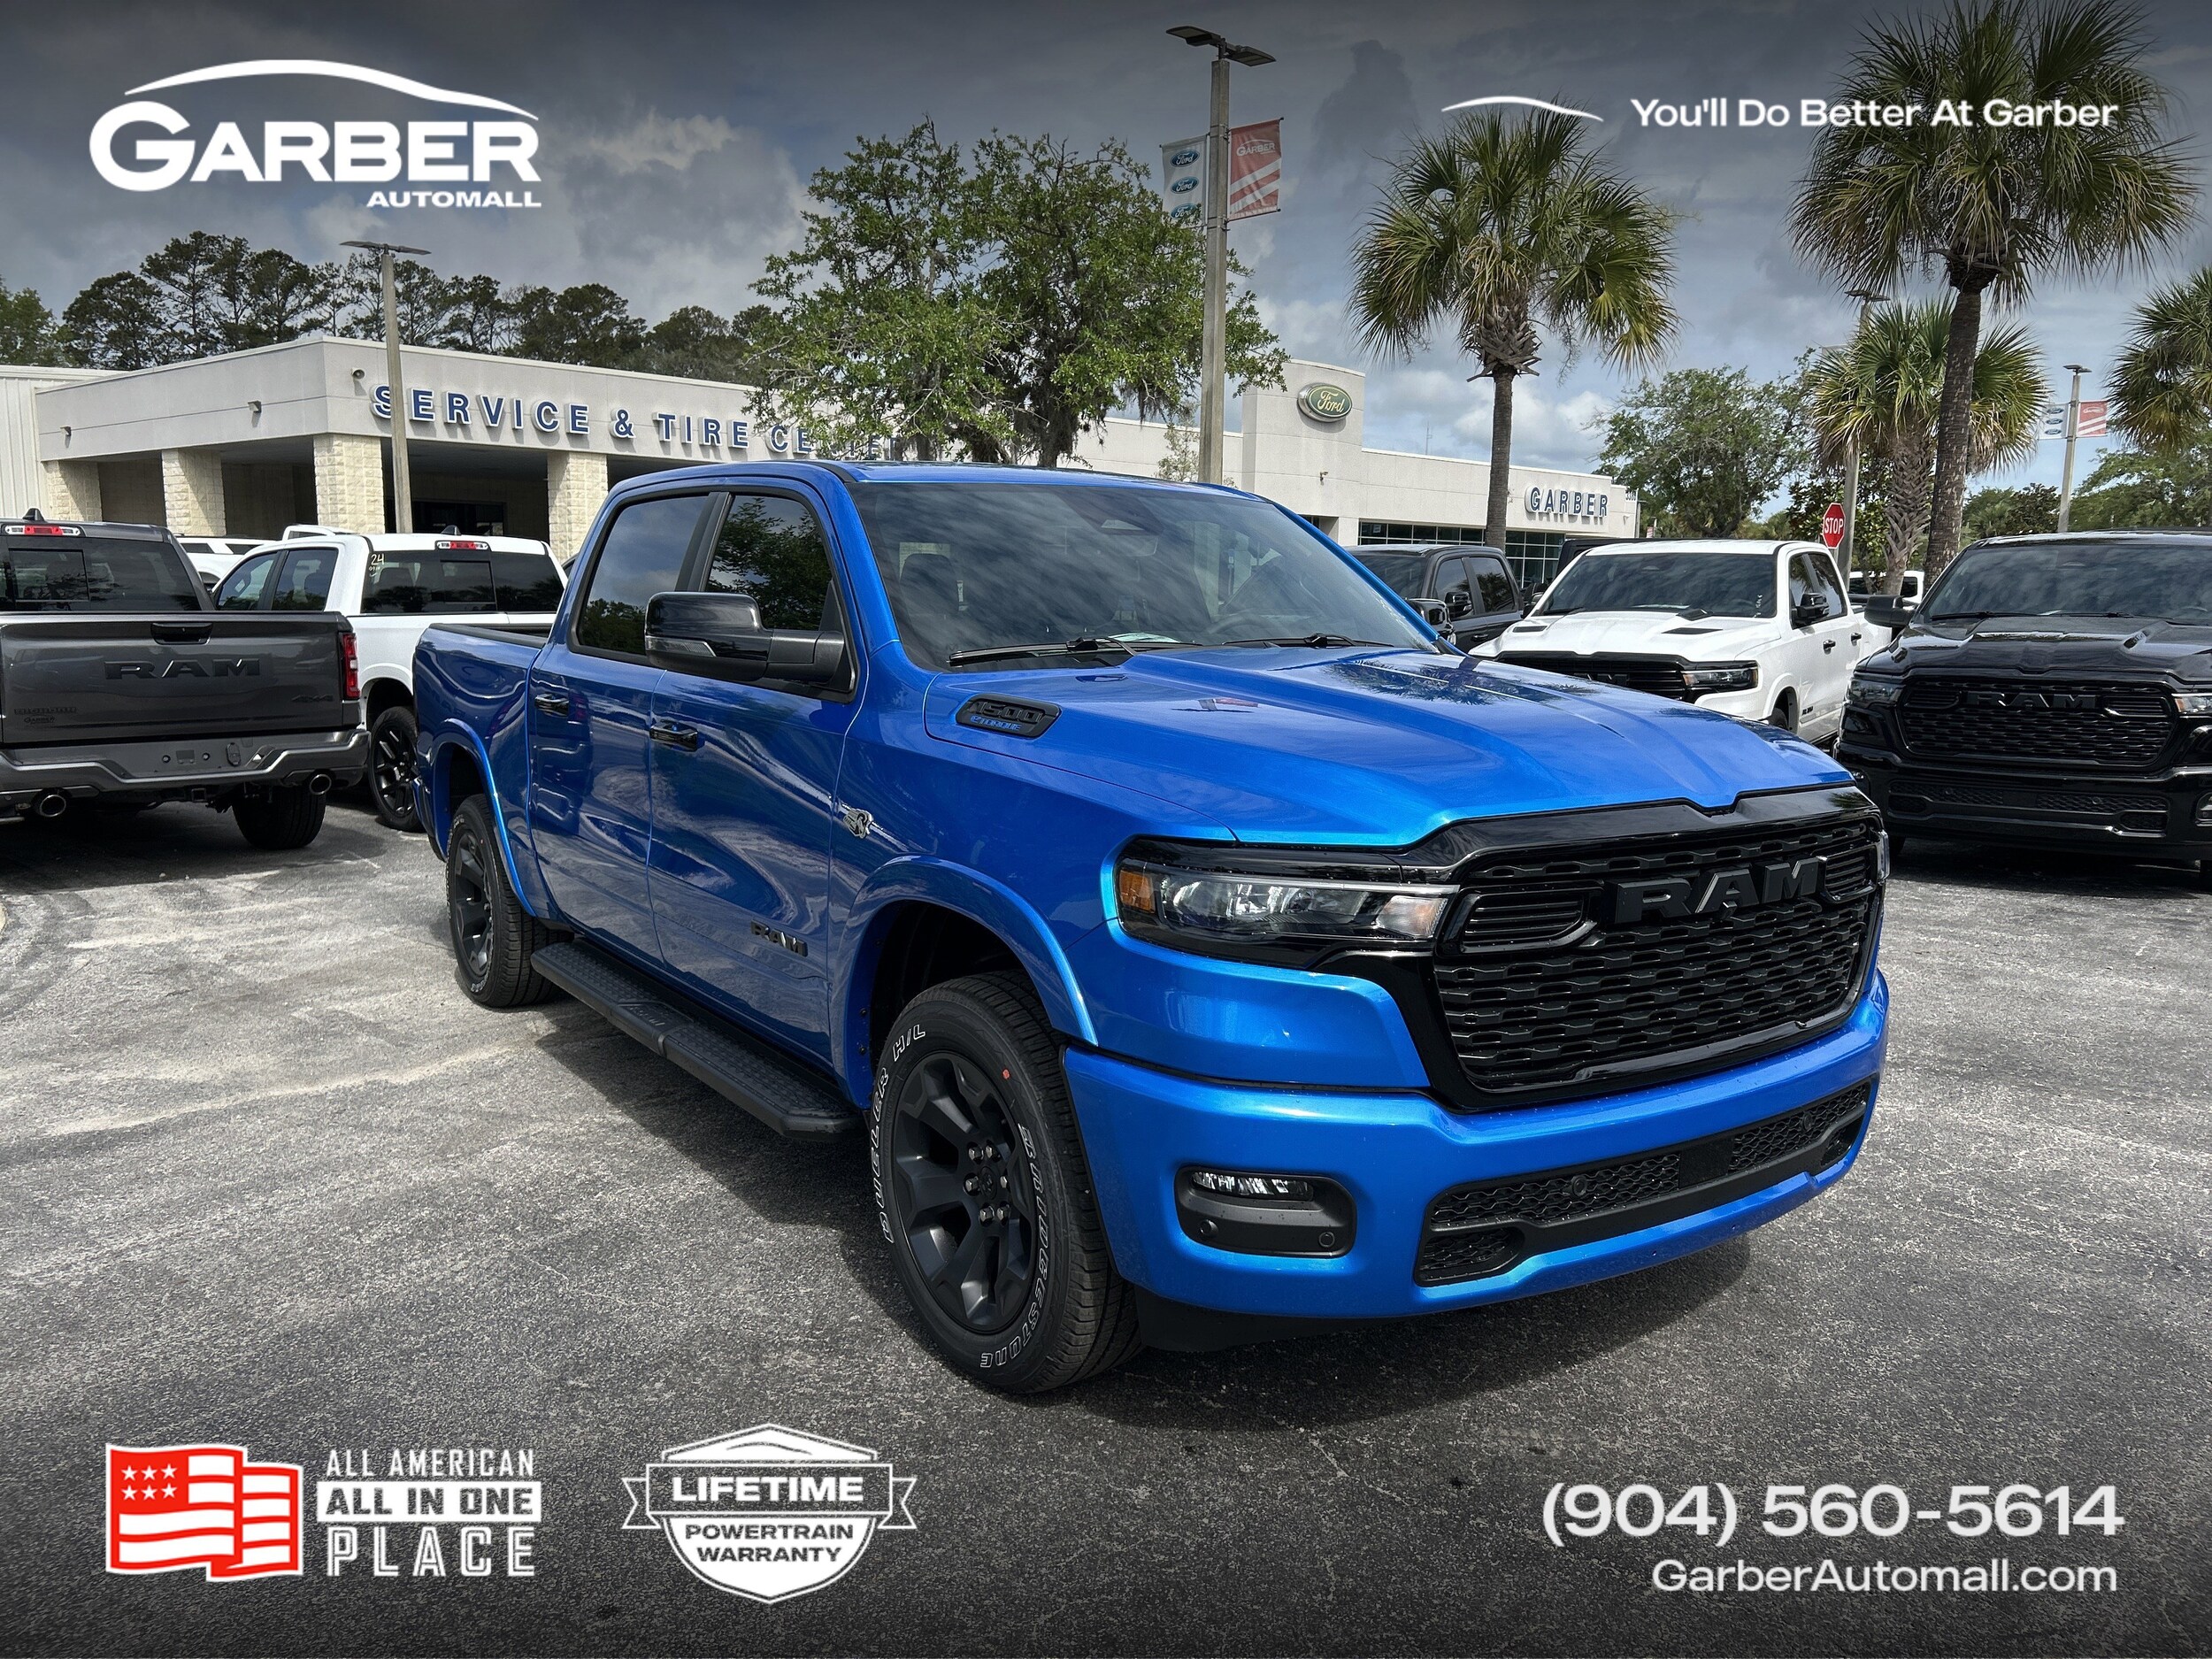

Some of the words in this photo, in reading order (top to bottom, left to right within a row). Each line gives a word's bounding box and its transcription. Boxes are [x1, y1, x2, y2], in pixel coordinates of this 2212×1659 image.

[1175, 152, 1194, 165] Ford
[1175, 179, 1194, 192] Ford
[1317, 390, 1346, 413] Ford
[370, 385, 590, 434] SERVICE
[610, 408, 635, 438] &
[654, 412, 749, 449] TIRE
[1525, 486, 1609, 518] GARBER
[1824, 517, 1844, 534] STOP
[371, 553, 385, 565] 24
[104, 658, 260, 679] RAM
[1966, 690, 2097, 710] RAM
[1616, 856, 1818, 924] RAM
[750, 919, 808, 957] RAM
